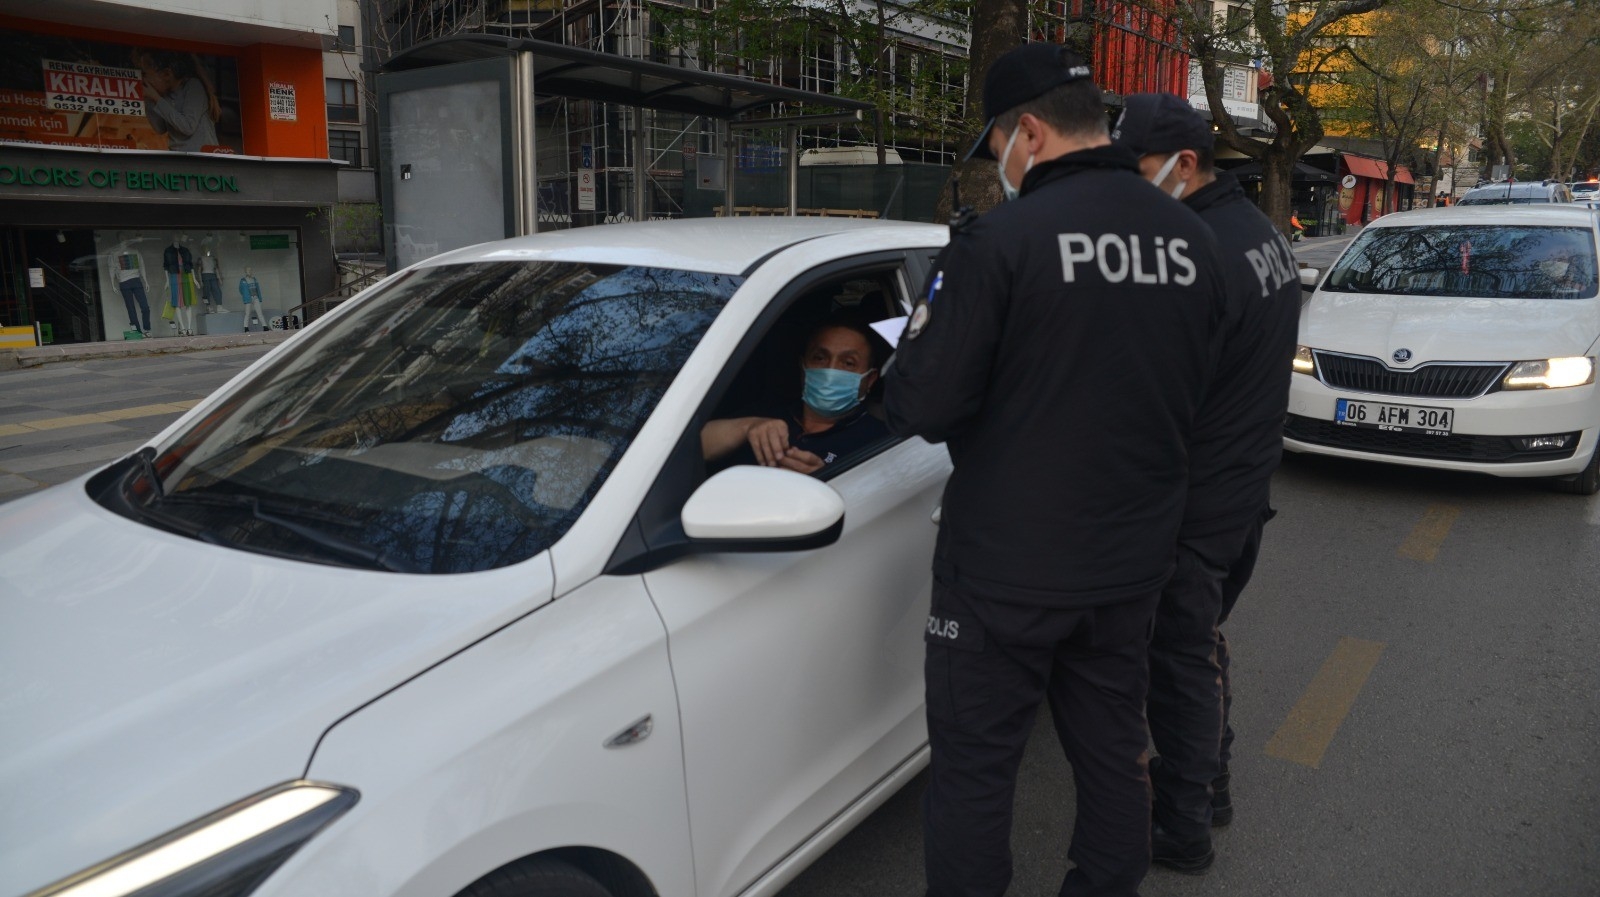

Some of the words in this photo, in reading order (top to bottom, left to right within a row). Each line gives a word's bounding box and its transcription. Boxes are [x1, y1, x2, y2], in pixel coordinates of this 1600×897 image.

[49, 61, 74, 71] RENK
[270, 88, 294, 96] RENK
[53, 94, 87, 104] 440
[94, 98, 115, 106] 10
[121, 100, 141, 108] 30
[54, 102, 84, 111] 0532
[88, 105, 109, 113] 569
[39, 117, 63, 131] için
[88, 168, 121, 188] OF
[1347, 403, 1366, 421] 06
[1378, 406, 1410, 425] AFM
[1417, 409, 1449, 428] 304
